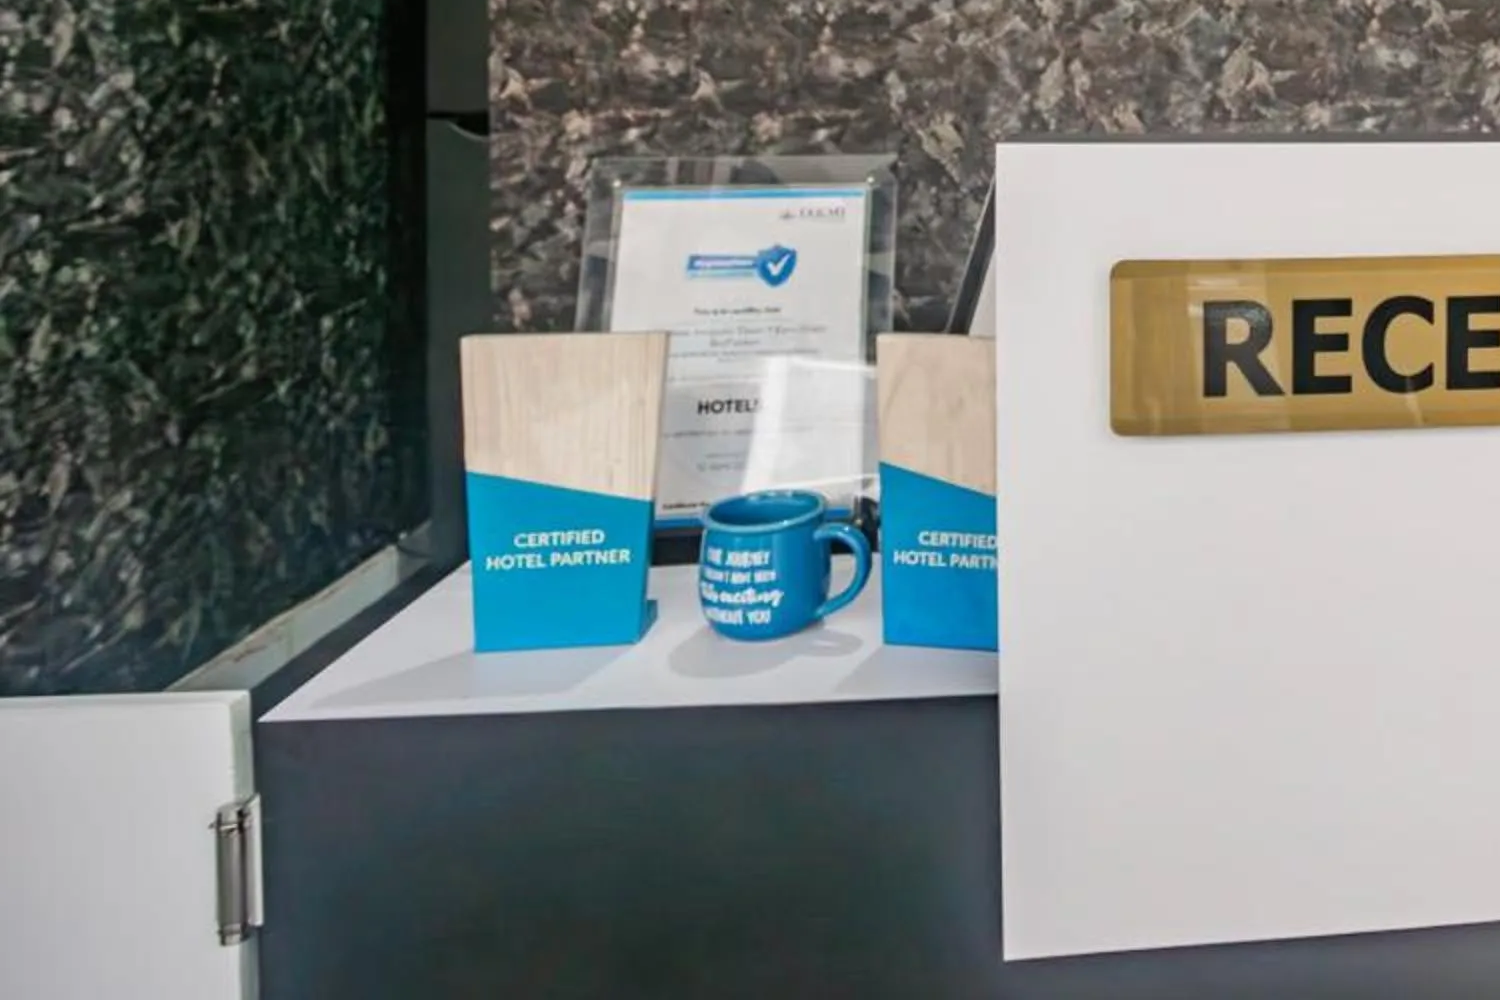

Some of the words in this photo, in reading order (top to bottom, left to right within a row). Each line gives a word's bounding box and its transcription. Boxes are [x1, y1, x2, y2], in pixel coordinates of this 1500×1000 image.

[513, 528, 606, 549] CERTIFIED
[485, 552, 547, 572] HOTEL
[551, 548, 632, 568] PARTNER
[893, 549, 947, 568] HOTEL
[950, 553, 997, 572] PART
